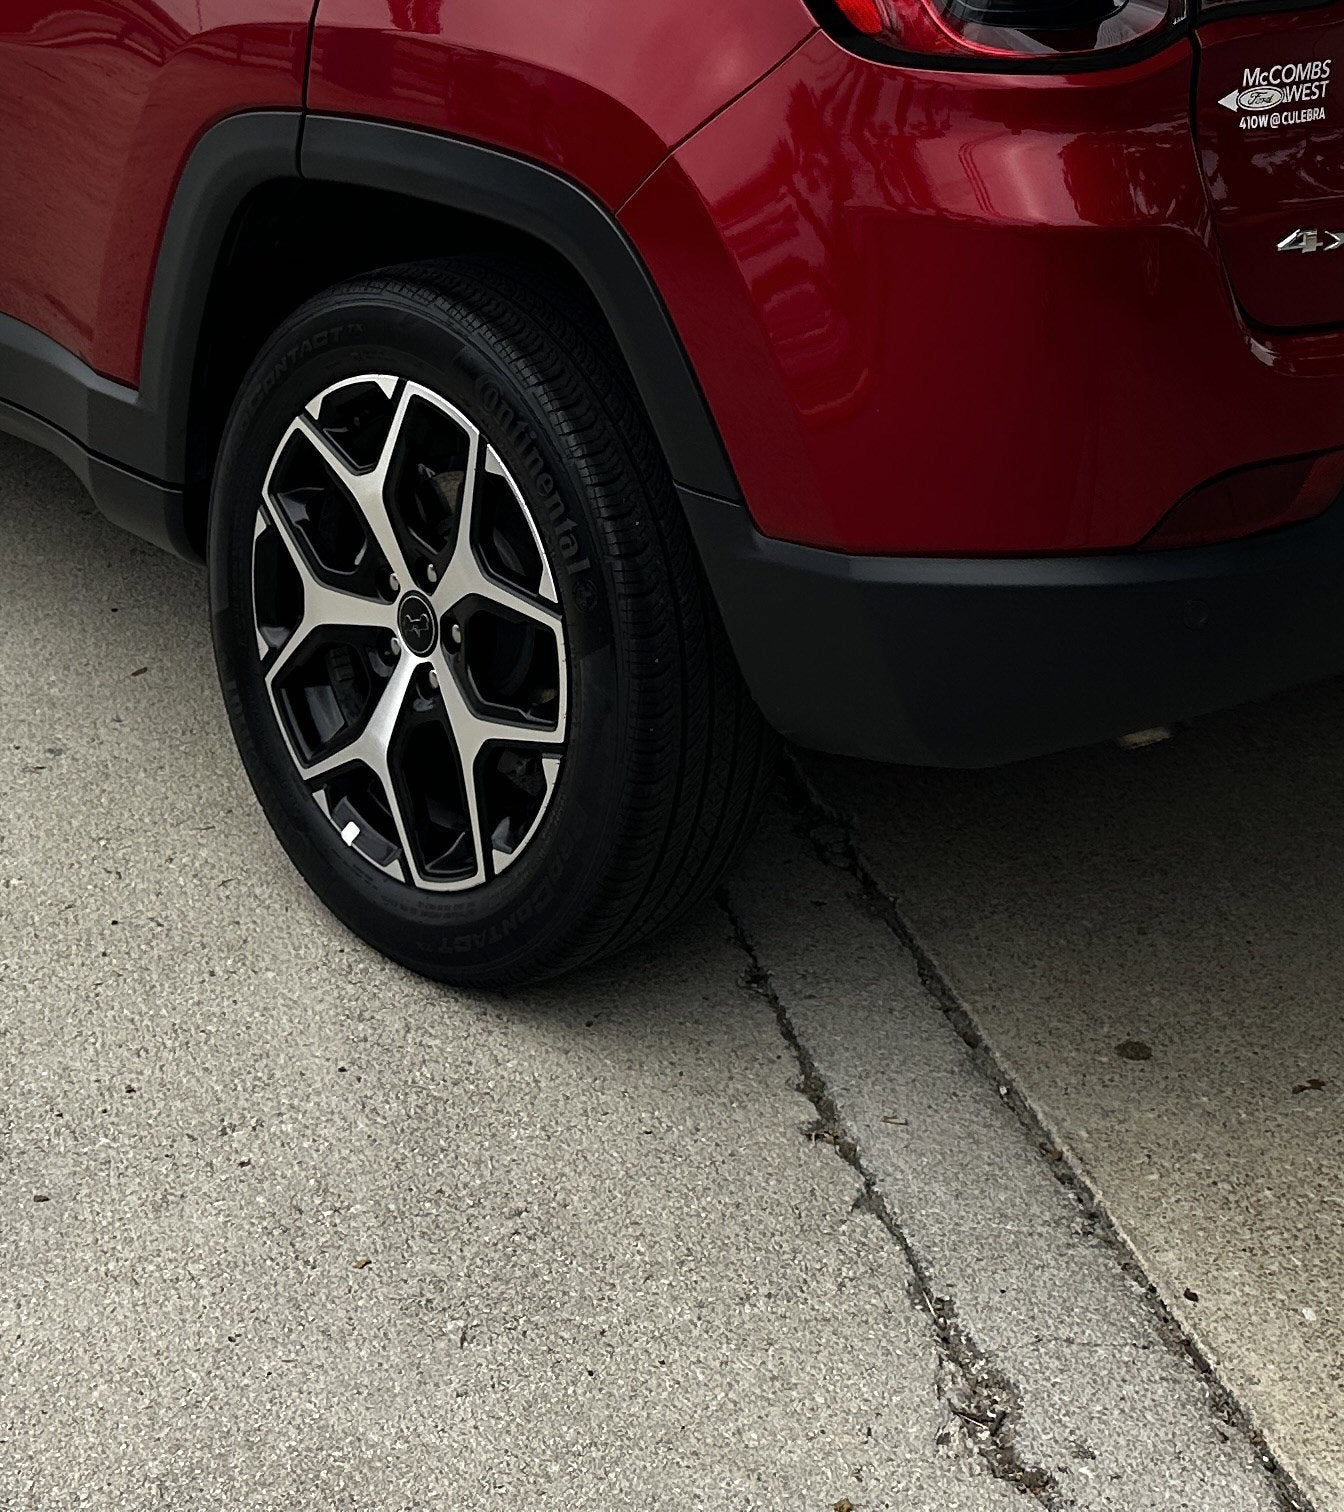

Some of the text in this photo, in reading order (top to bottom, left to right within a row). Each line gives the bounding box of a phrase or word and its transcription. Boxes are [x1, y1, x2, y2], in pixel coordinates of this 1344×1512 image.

[1242, 59, 1331, 87] McCOMBS
[1247, 91, 1275, 106] Ford
[1281, 80, 1330, 103] WEST
